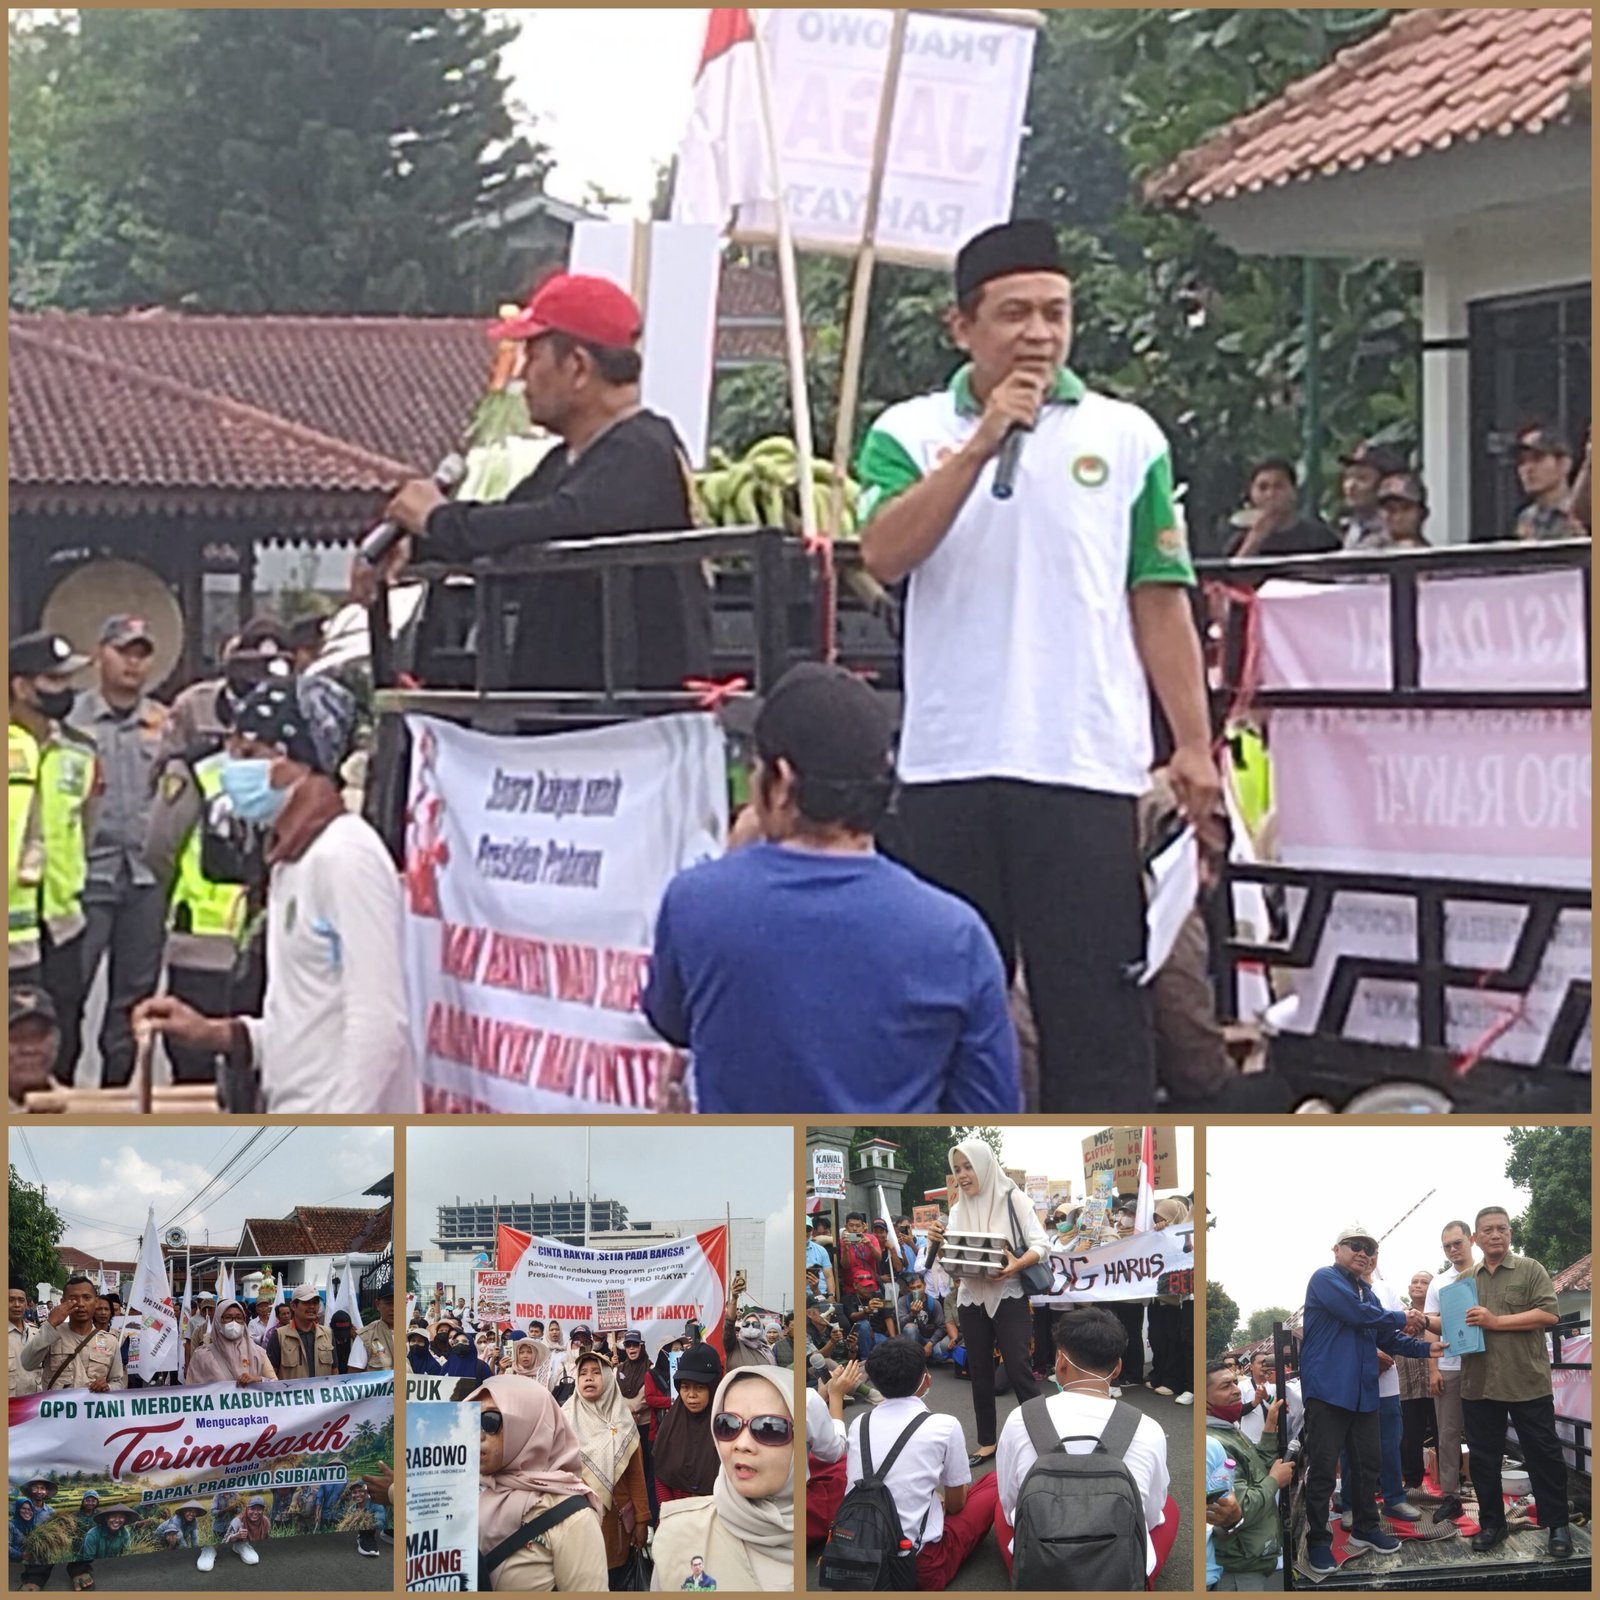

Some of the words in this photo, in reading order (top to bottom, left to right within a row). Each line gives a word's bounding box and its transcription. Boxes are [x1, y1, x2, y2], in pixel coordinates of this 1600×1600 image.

[816, 1155, 841, 1163] KAWAL
[1084, 1158, 1116, 1179] LAPANG
[563, 1251, 595, 1261] RAKYAT
[625, 1252, 648, 1261] PADA
[528, 1260, 557, 1270] Rakyat
[559, 1265, 607, 1275] Mendukung
[609, 1268, 645, 1276] Program
[647, 1263, 684, 1274] program
[1048, 1255, 1099, 1296] BG
[1104, 1253, 1164, 1286] HARUS
[483, 1278, 507, 1286] MBG
[528, 1271, 564, 1280] Presiden
[566, 1275, 602, 1284] Prabowo
[654, 1272, 688, 1281] RAKYAT
[516, 1303, 546, 1320] MBG,
[550, 1304, 593, 1320] KDKMP
[631, 1305, 653, 1321] LAH
[656, 1305, 704, 1320] RAKYAT
[406, 1379, 442, 1401] PUK
[84, 1399, 126, 1419] TANI
[131, 1394, 215, 1417] MERDEKA
[219, 1388, 316, 1411] KABUPATEN
[196, 1414, 269, 1430] Mengucapkan
[103, 1413, 351, 1482] Terimakasih
[406, 1444, 467, 1470] RABOWO
[224, 1461, 260, 1476] kepada
[143, 1484, 194, 1502] BAPAK
[198, 1473, 270, 1493] PRABOWO
[275, 1465, 347, 1485] SUBIANTO
